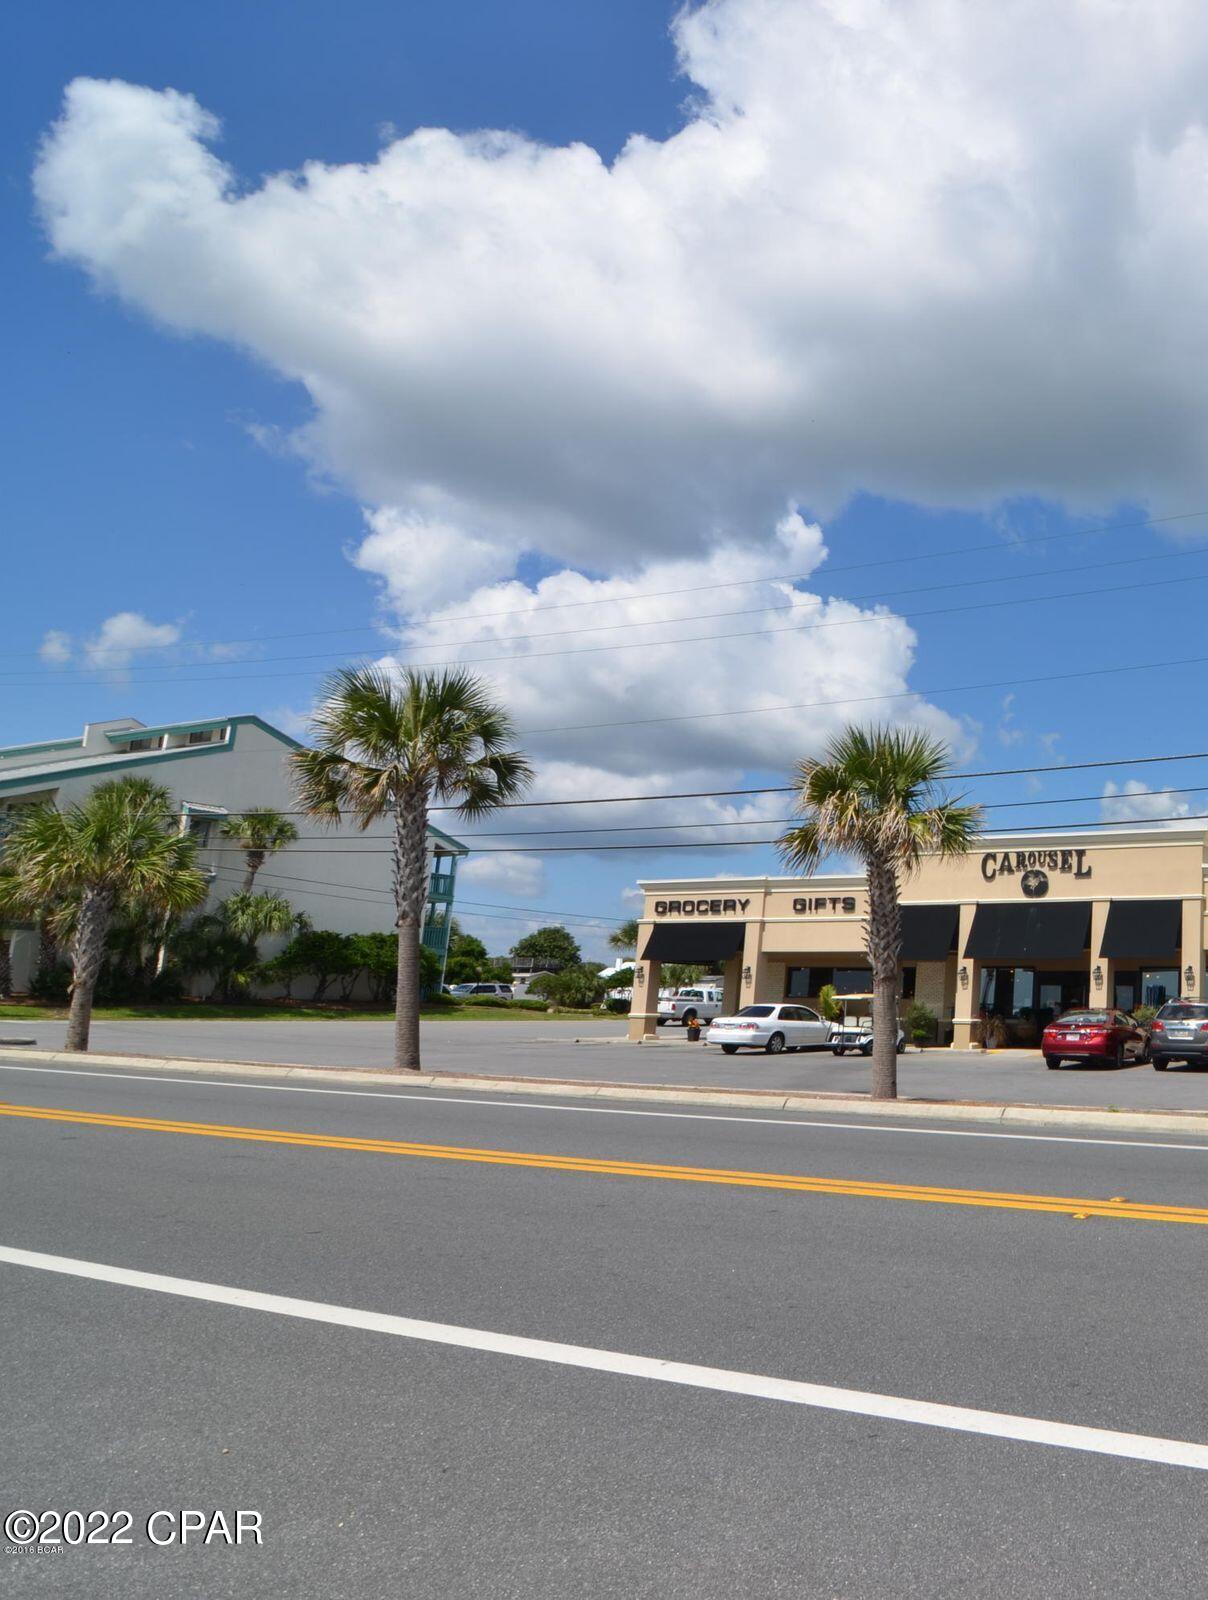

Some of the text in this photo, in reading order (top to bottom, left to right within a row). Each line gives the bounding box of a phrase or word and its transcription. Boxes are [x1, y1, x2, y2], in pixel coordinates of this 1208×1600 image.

[981, 849, 1092, 882] CAROUSEL
[654, 899, 749, 916] GROCERY
[792, 896, 856, 914] GIFTS
